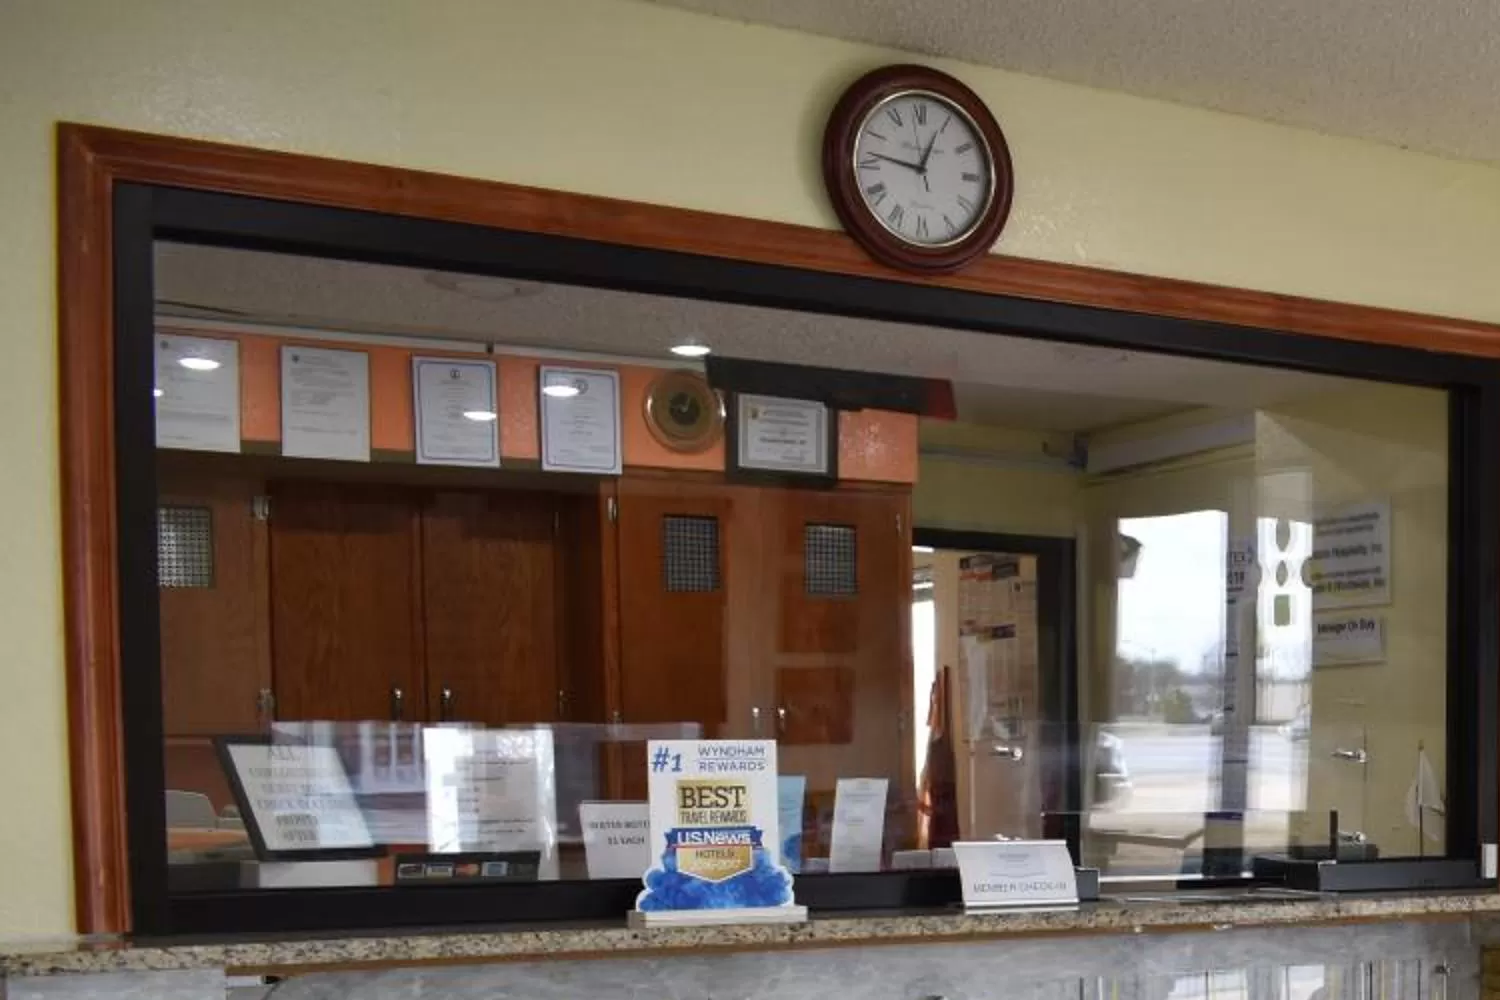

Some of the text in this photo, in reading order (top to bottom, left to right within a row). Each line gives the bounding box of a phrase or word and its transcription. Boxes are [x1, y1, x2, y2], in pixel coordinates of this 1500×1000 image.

[652, 745, 766, 773] #1 WYNDHAM
[698, 759, 766, 771] REWARDS
[680, 785, 747, 809] BEST
[680, 810, 709, 825] TRAVEL
